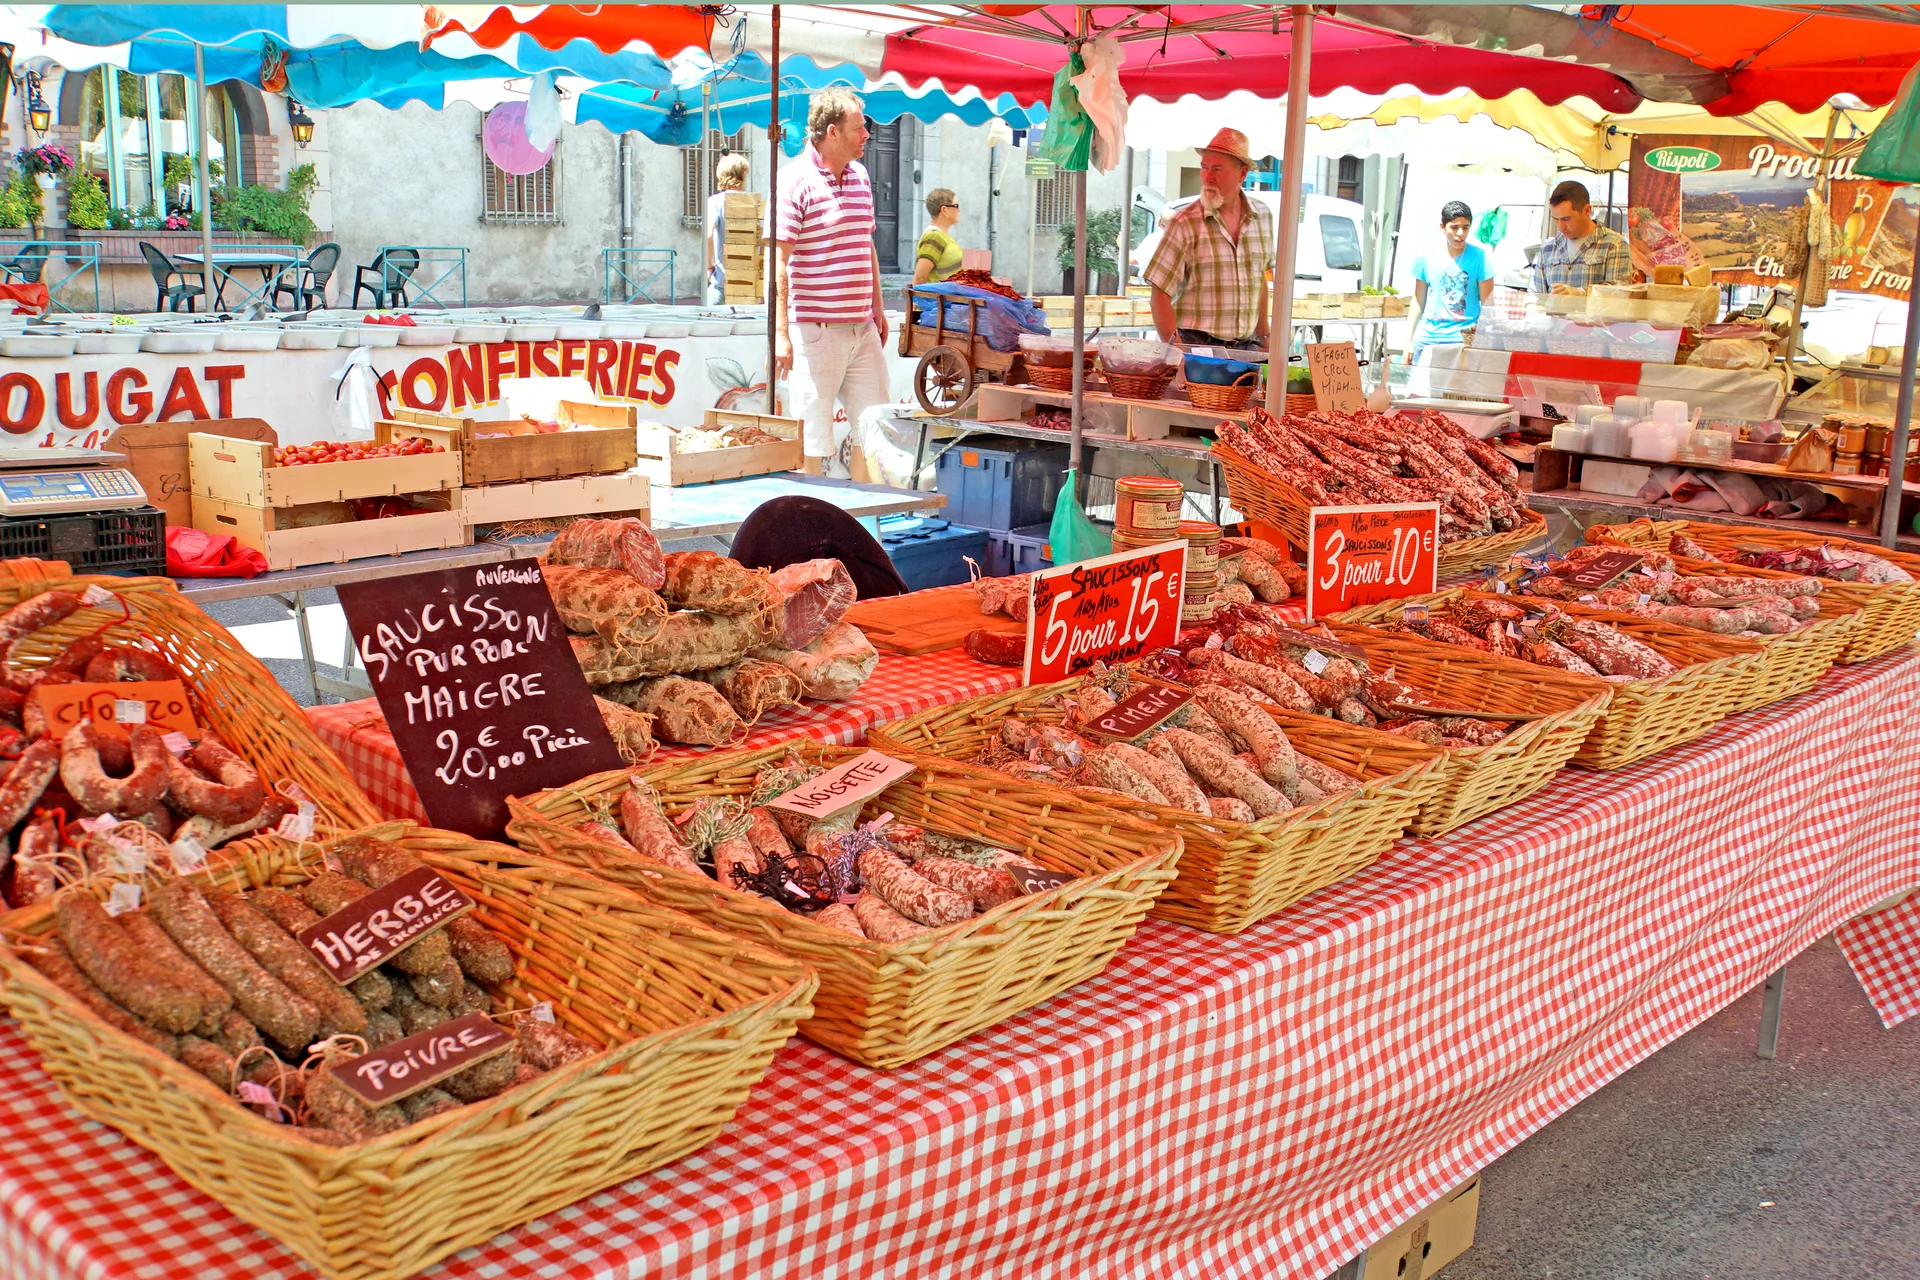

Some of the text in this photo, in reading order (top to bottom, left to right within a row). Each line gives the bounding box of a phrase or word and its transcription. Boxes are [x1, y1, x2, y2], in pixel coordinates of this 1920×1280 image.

[1655, 149, 1709, 172] Rispoli
[1322, 346, 1355, 363] FAGOT
[1323, 363, 1351, 376] CROC
[375, 339, 681, 419] CONFISERIES
[475, 564, 542, 587] AUVERGNE
[1320, 528, 1345, 590] 3
[1341, 559, 1382, 601] pour
[1041, 590, 1073, 666] 5
[1065, 618, 1117, 675] pour
[406, 644, 468, 677] PUR
[56, 692, 183, 723] CHOZO
[310, 876, 457, 970] HERBE
[353, 897, 464, 974] DE PROVENCE
